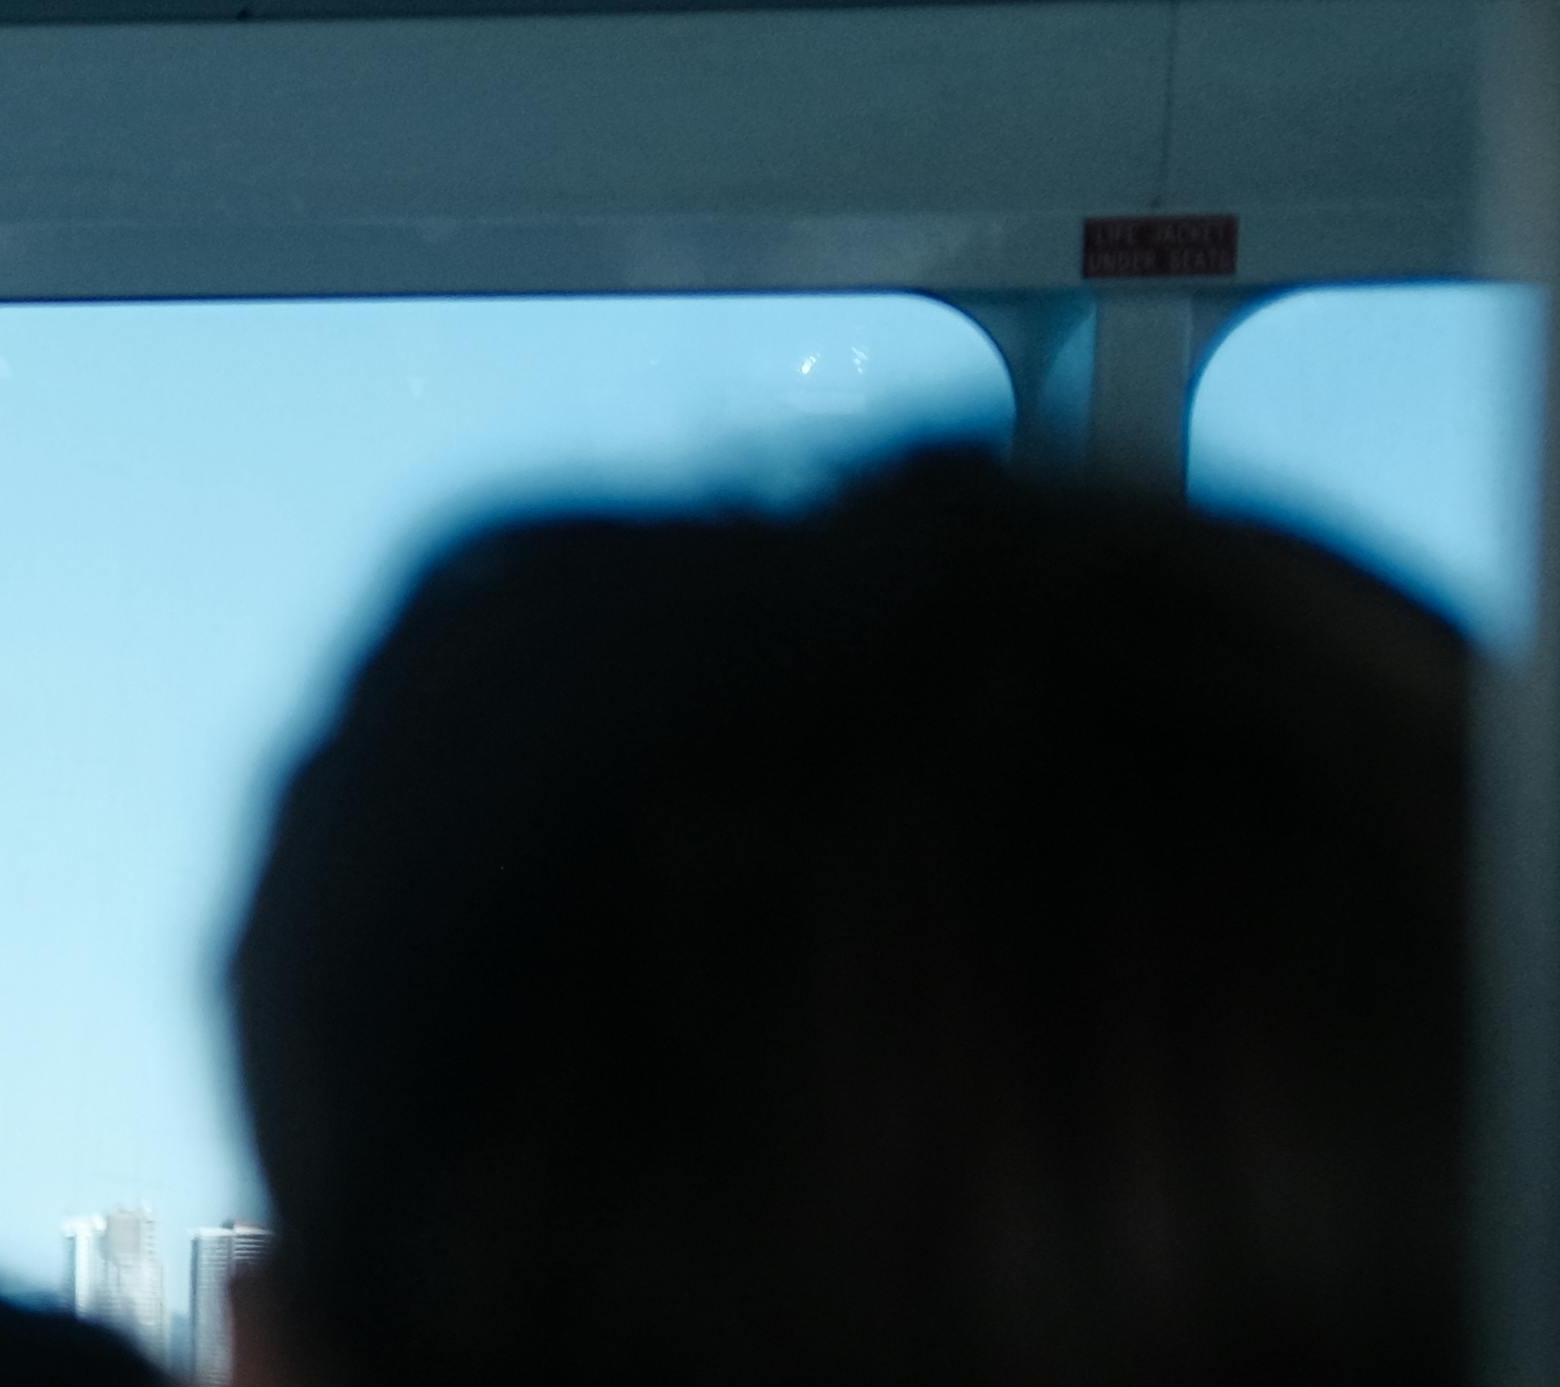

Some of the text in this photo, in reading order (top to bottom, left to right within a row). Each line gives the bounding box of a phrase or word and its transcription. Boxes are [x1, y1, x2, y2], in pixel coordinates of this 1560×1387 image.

[1096, 221, 1226, 246] LIFE JACKET
[1088, 249, 1157, 274] UNDER
